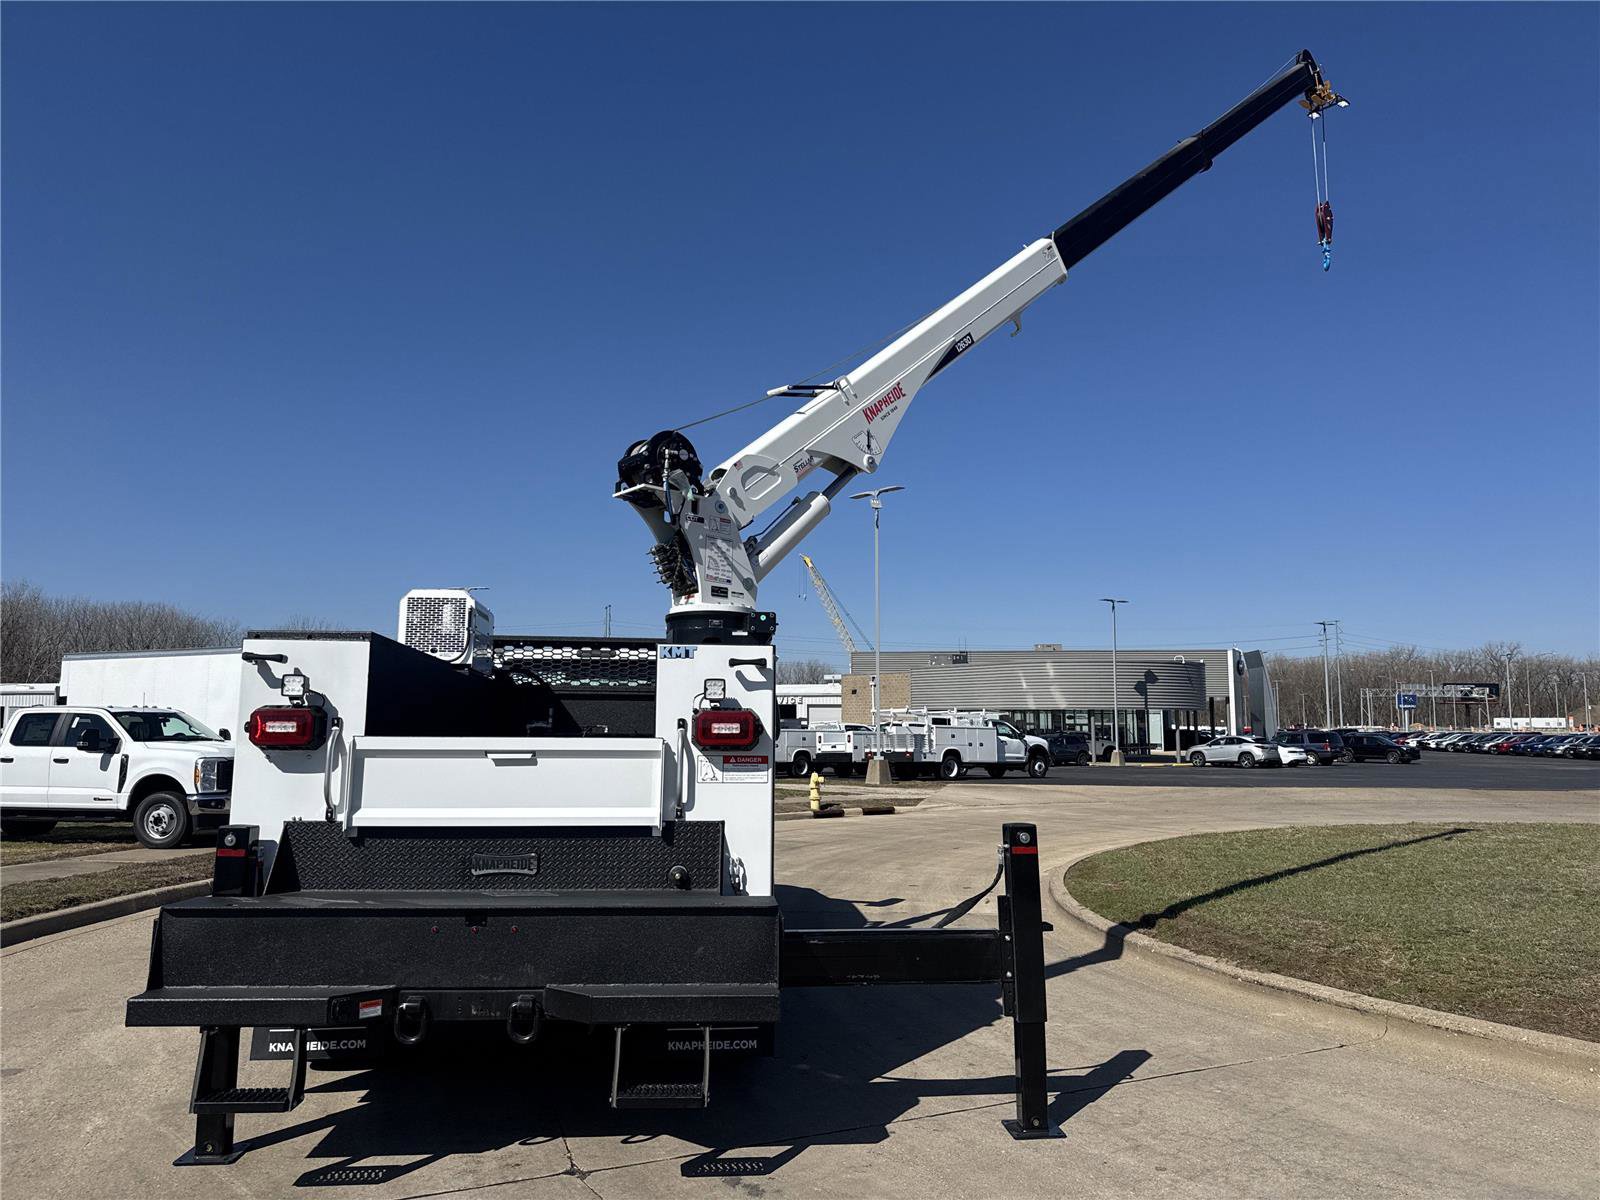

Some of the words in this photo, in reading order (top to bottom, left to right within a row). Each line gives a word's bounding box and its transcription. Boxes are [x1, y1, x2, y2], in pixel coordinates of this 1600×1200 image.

[955, 335, 972, 353] 12630
[862, 381, 907, 425] KNAPHEIDE
[793, 455, 815, 474] STELLAR
[659, 645, 698, 660] KMT
[472, 855, 538, 873] KNAPHEIDE
[268, 1039, 367, 1053] KNAEIDE.COM
